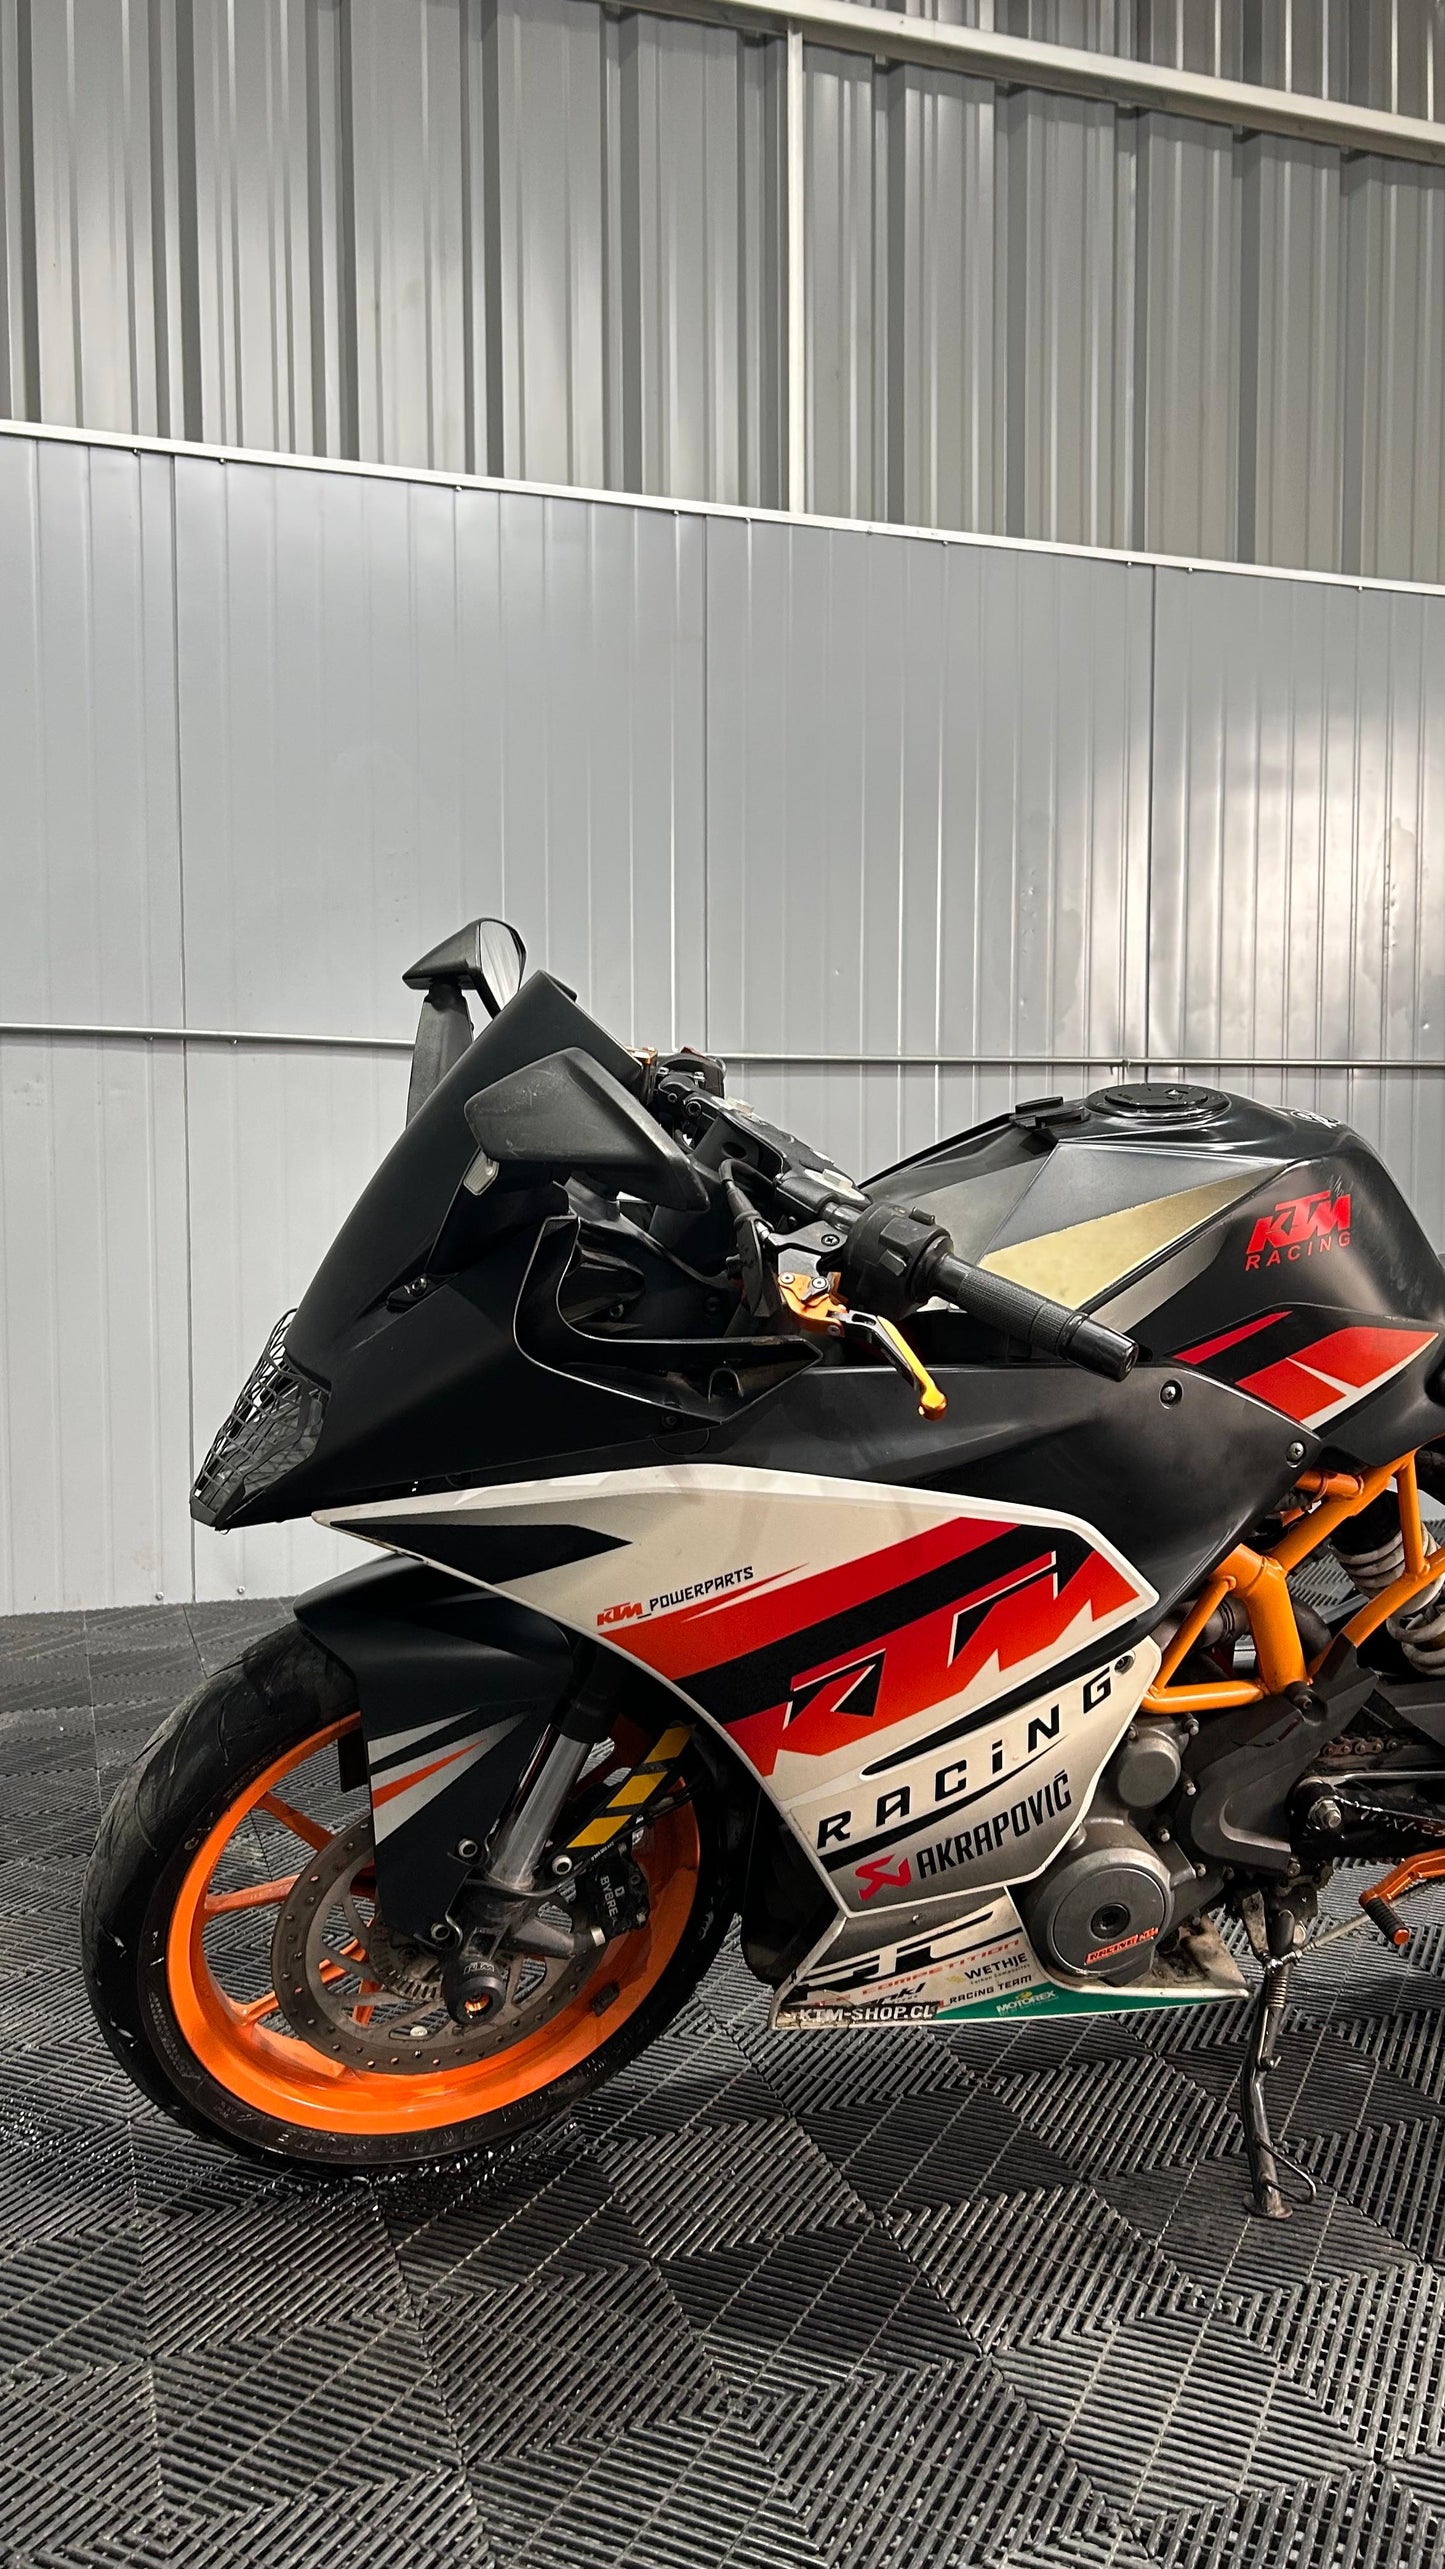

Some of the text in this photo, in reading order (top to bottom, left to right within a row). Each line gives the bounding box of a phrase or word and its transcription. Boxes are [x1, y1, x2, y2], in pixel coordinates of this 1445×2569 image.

[1246, 1189, 1351, 1254] KTM
[1245, 1232, 1351, 1271] RACING
[723, 1550, 1140, 1777] KTM
[964, 1952, 1028, 1980] WETHJE
[998, 1974, 1032, 1991] TEAM
[799, 2004, 934, 2021] KTM-SHOP.CL
[996, 1990, 1056, 2013] MOTOREX
